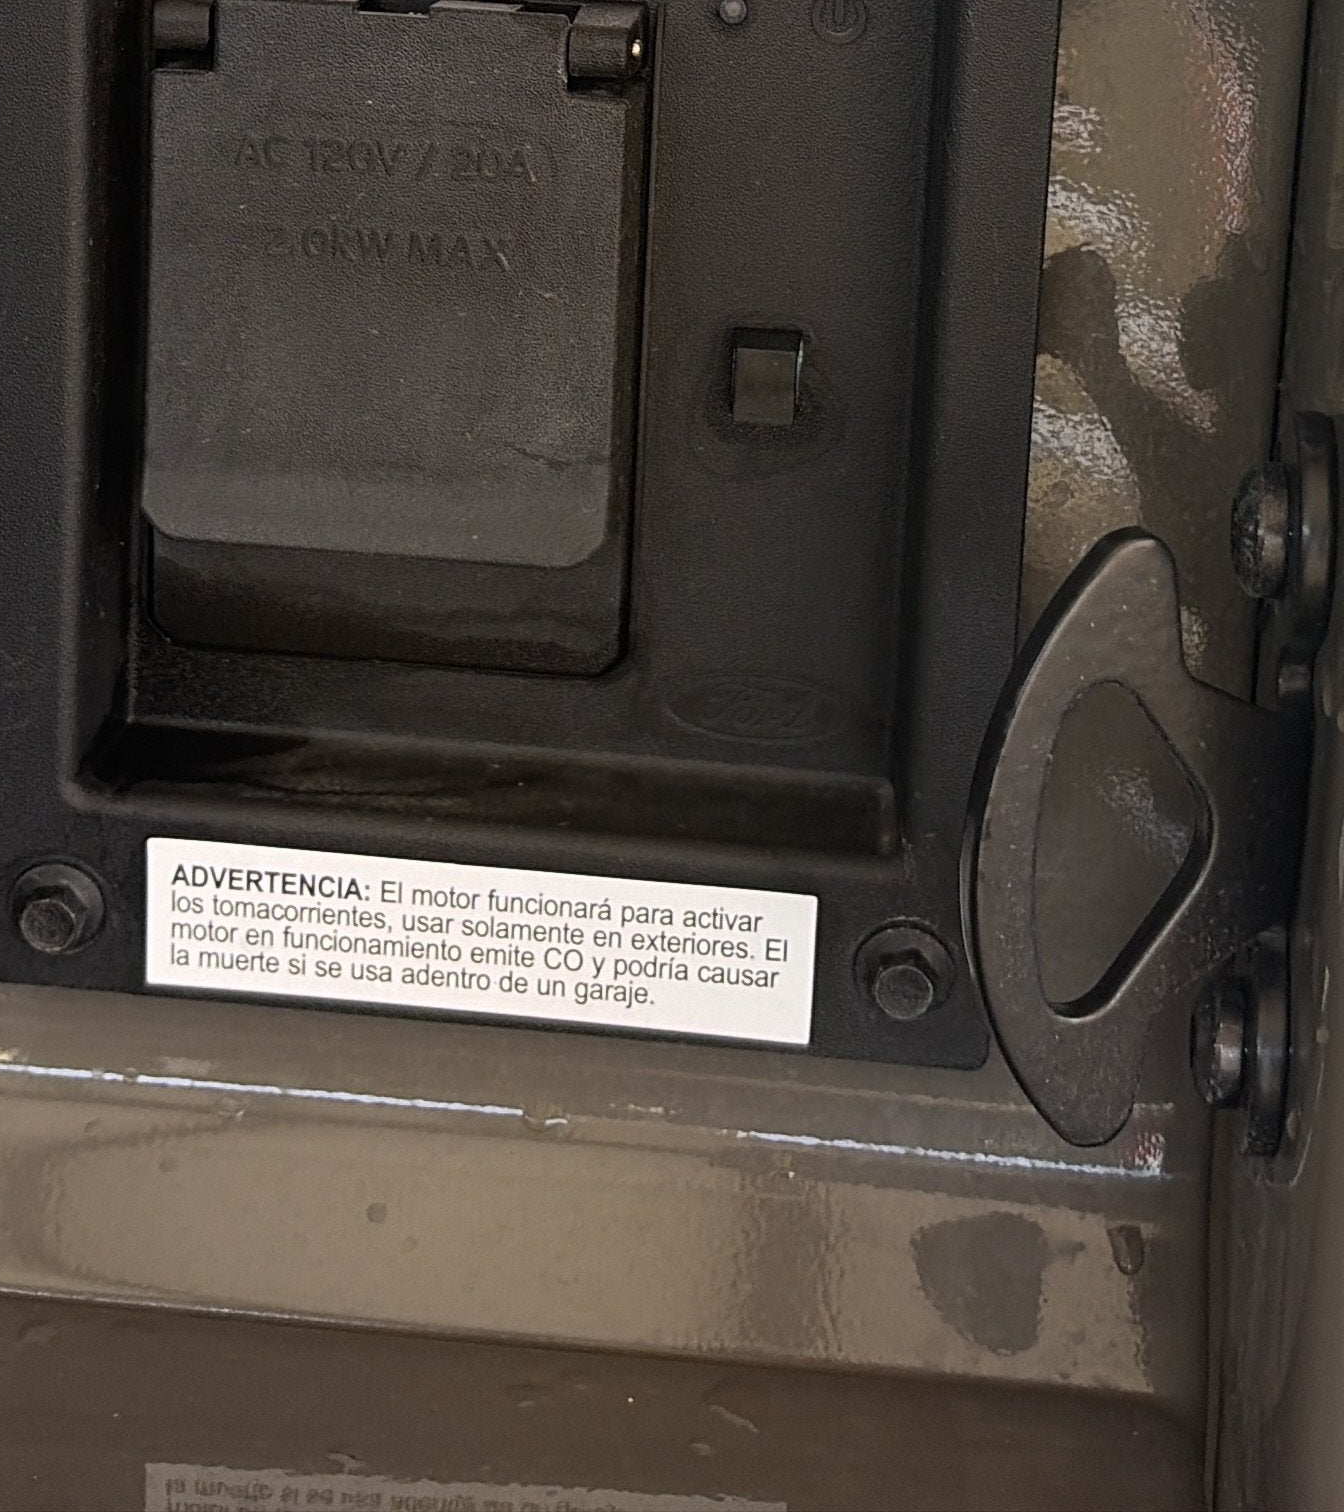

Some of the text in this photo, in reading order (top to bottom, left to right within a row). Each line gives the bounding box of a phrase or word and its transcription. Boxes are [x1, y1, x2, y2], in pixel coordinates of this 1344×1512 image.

[171, 864, 763, 932] ADVERTENCIA: El motor funcionará para activar
[172, 891, 787, 962] los tomacorrientes, usar solamente en exteriores. El
[171, 944, 654, 1008] la muerte si se usa adentro de un garaje.
[172, 921, 779, 988] motor en funcionamiento emite CO y podría causar
